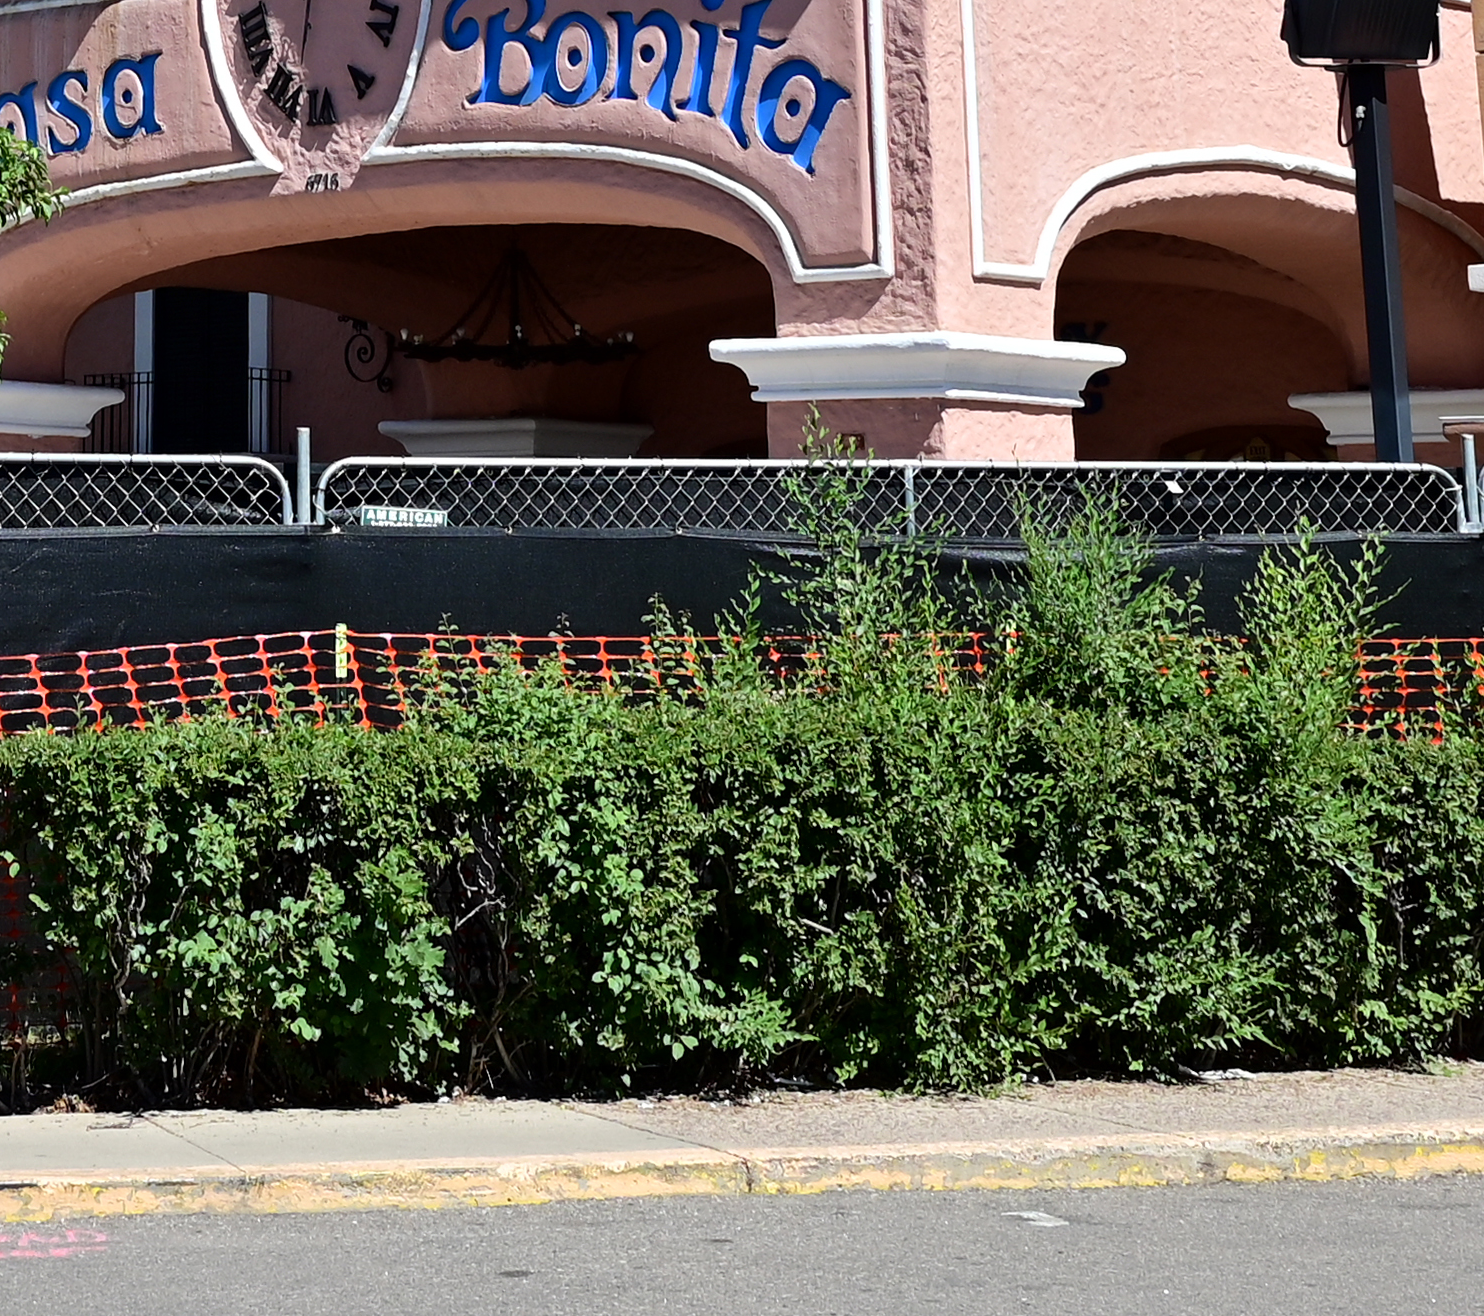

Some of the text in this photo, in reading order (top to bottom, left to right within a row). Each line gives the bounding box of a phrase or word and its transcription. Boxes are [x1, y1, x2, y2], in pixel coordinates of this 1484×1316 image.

[237, 0, 274, 78] VIII
[264, 62, 304, 124] VII
[347, 64, 375, 100] V
[307, 86, 337, 126] VI
[366, 509, 444, 524] AMERICAN
